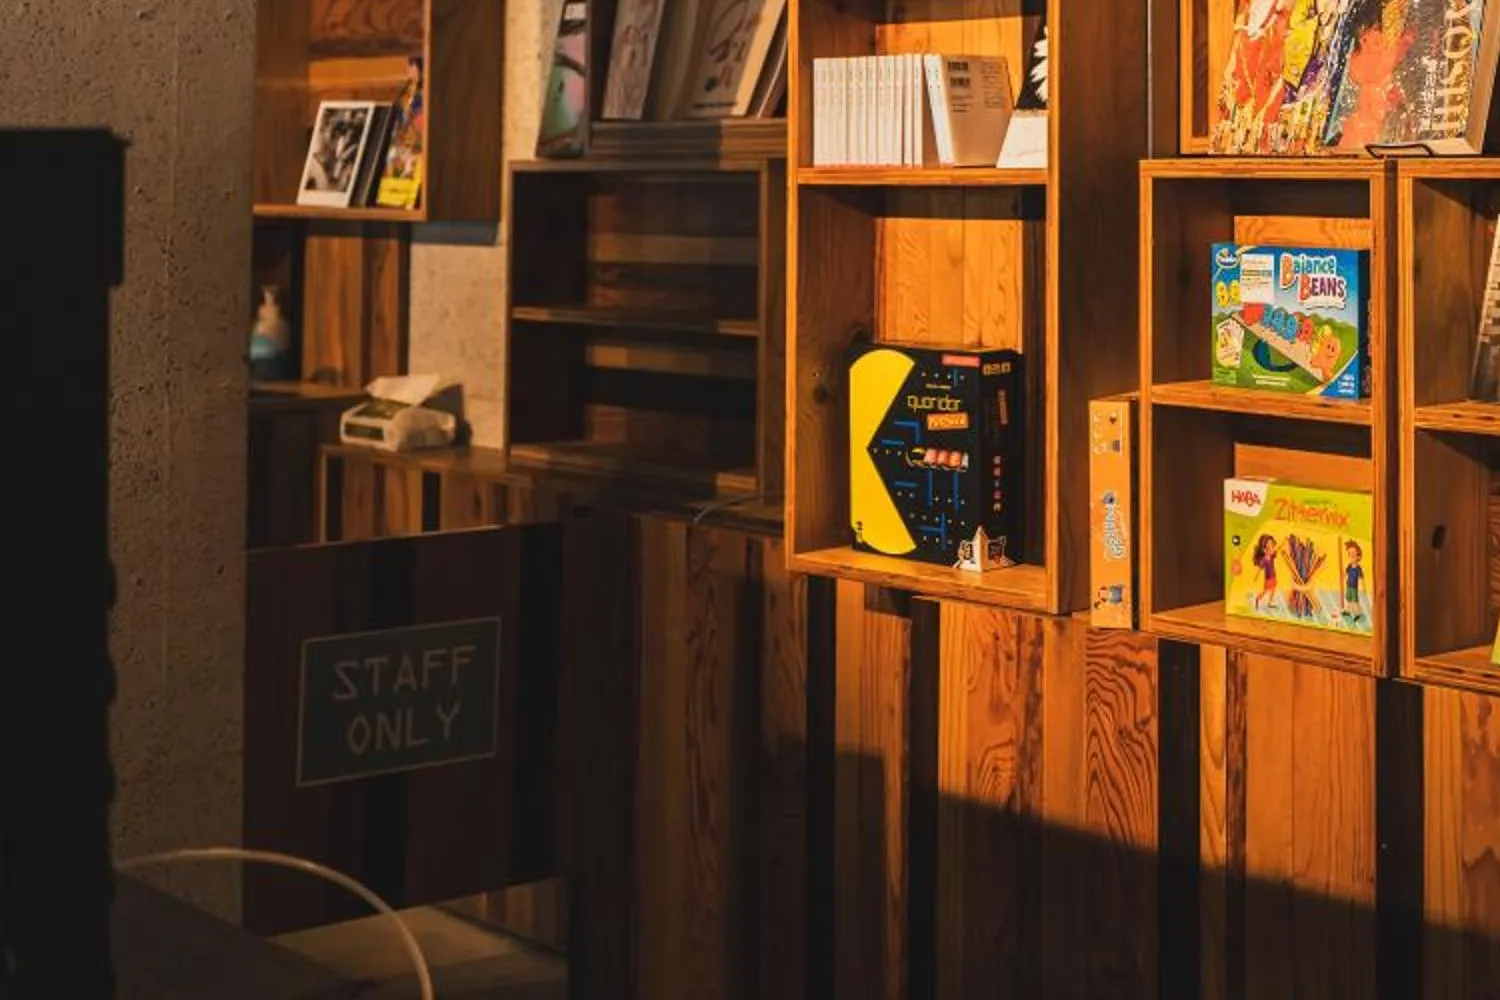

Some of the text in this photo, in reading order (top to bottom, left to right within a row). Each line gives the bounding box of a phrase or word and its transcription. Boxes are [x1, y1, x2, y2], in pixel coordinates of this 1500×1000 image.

[1281, 255, 1336, 287] Balance
[1300, 275, 1345, 301] BEANS
[1231, 490, 1261, 508] HABA
[333, 645, 477, 700] STAFF
[348, 699, 461, 755] ONLY
